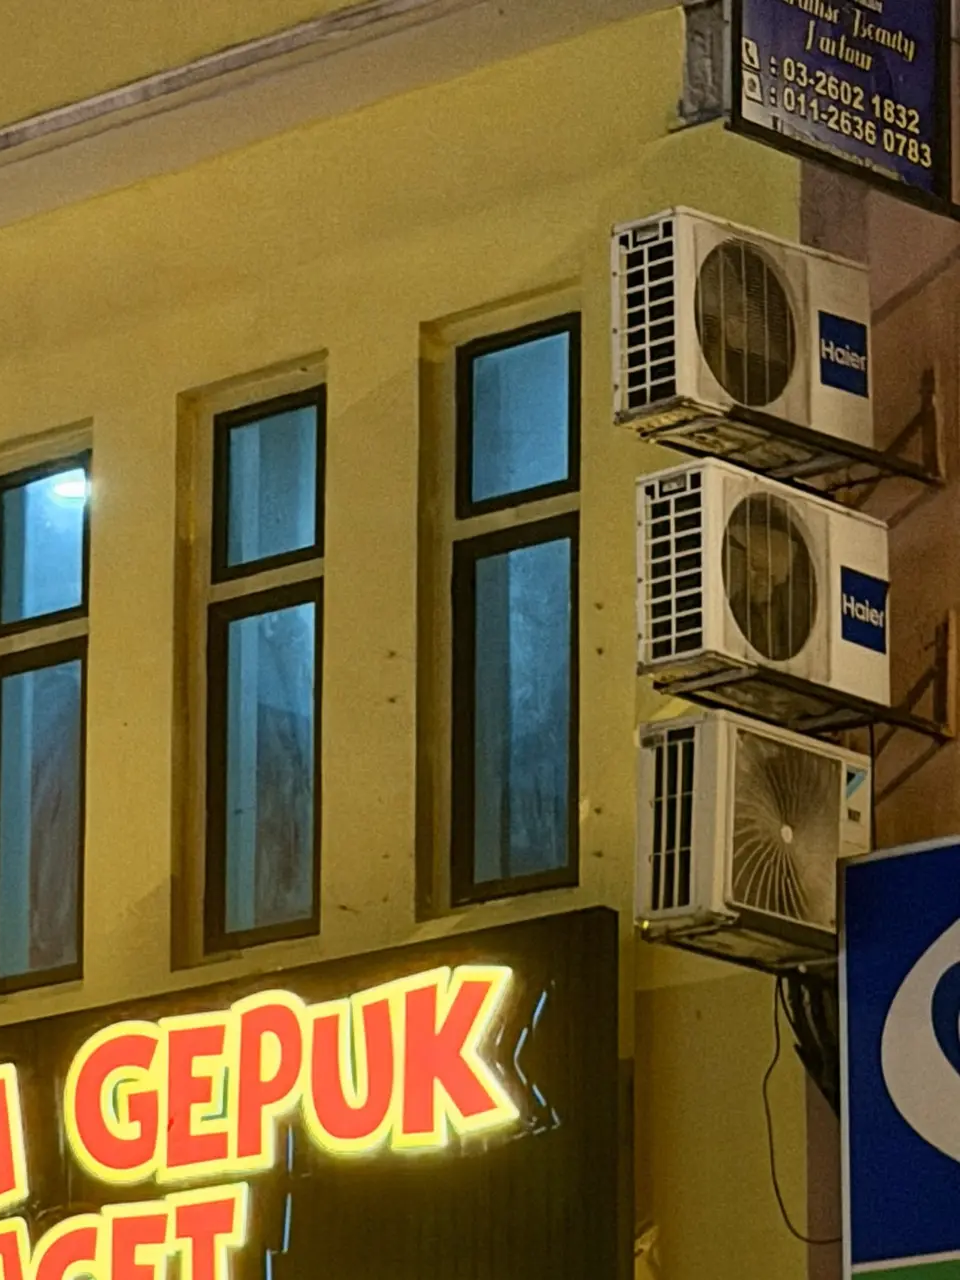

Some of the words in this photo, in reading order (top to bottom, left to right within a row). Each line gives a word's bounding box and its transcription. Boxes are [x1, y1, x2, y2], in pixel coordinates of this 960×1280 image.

[783, 58, 865, 111] 03-2602
[871, 94, 921, 134] 1832
[783, 87, 877, 145] 011-2636
[883, 129, 932, 168] 0783
[821, 338, 866, 371] Haier
[842, 593, 884, 628] Haier
[65, 966, 520, 1184] GEPUK
